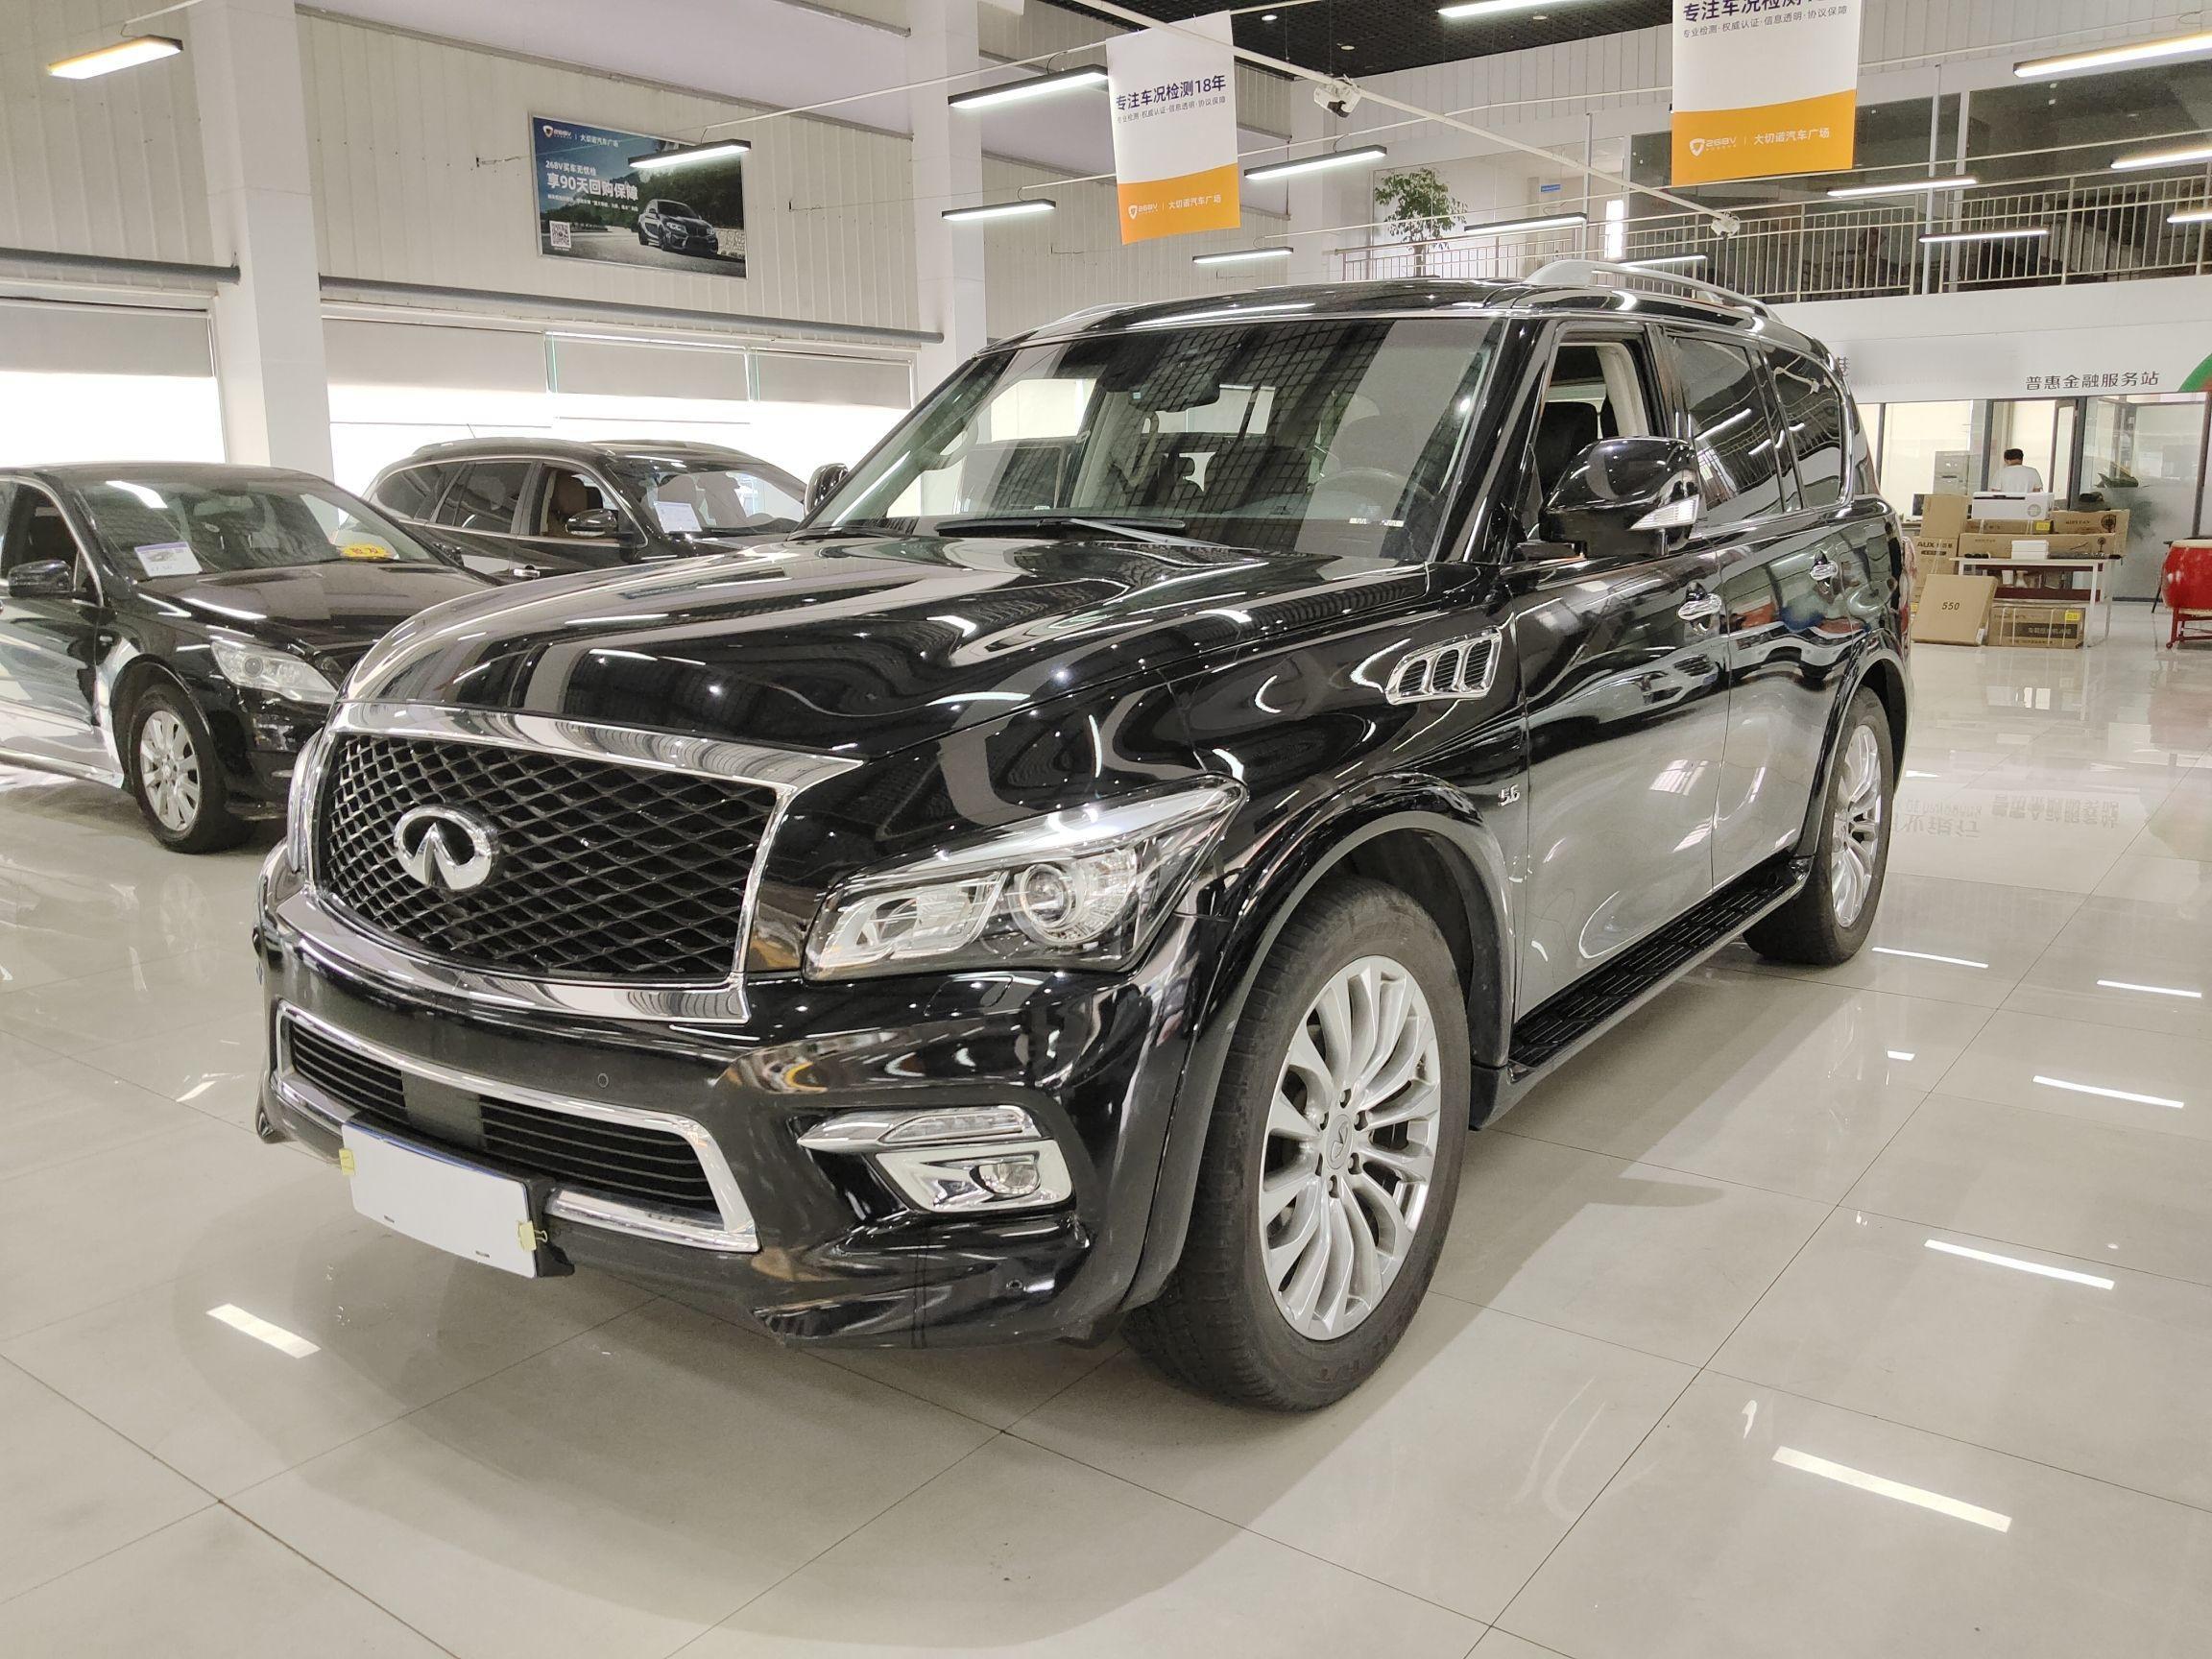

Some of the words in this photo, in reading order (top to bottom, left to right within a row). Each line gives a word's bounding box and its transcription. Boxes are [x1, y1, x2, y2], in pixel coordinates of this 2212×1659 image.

[1116, 75, 1226, 111] 专注车况检测18年
[547, 173, 638, 201] 享90天回购保障
[2026, 371, 2159, 390] 普惠金融服务站
[1941, 602, 1960, 611] 550
